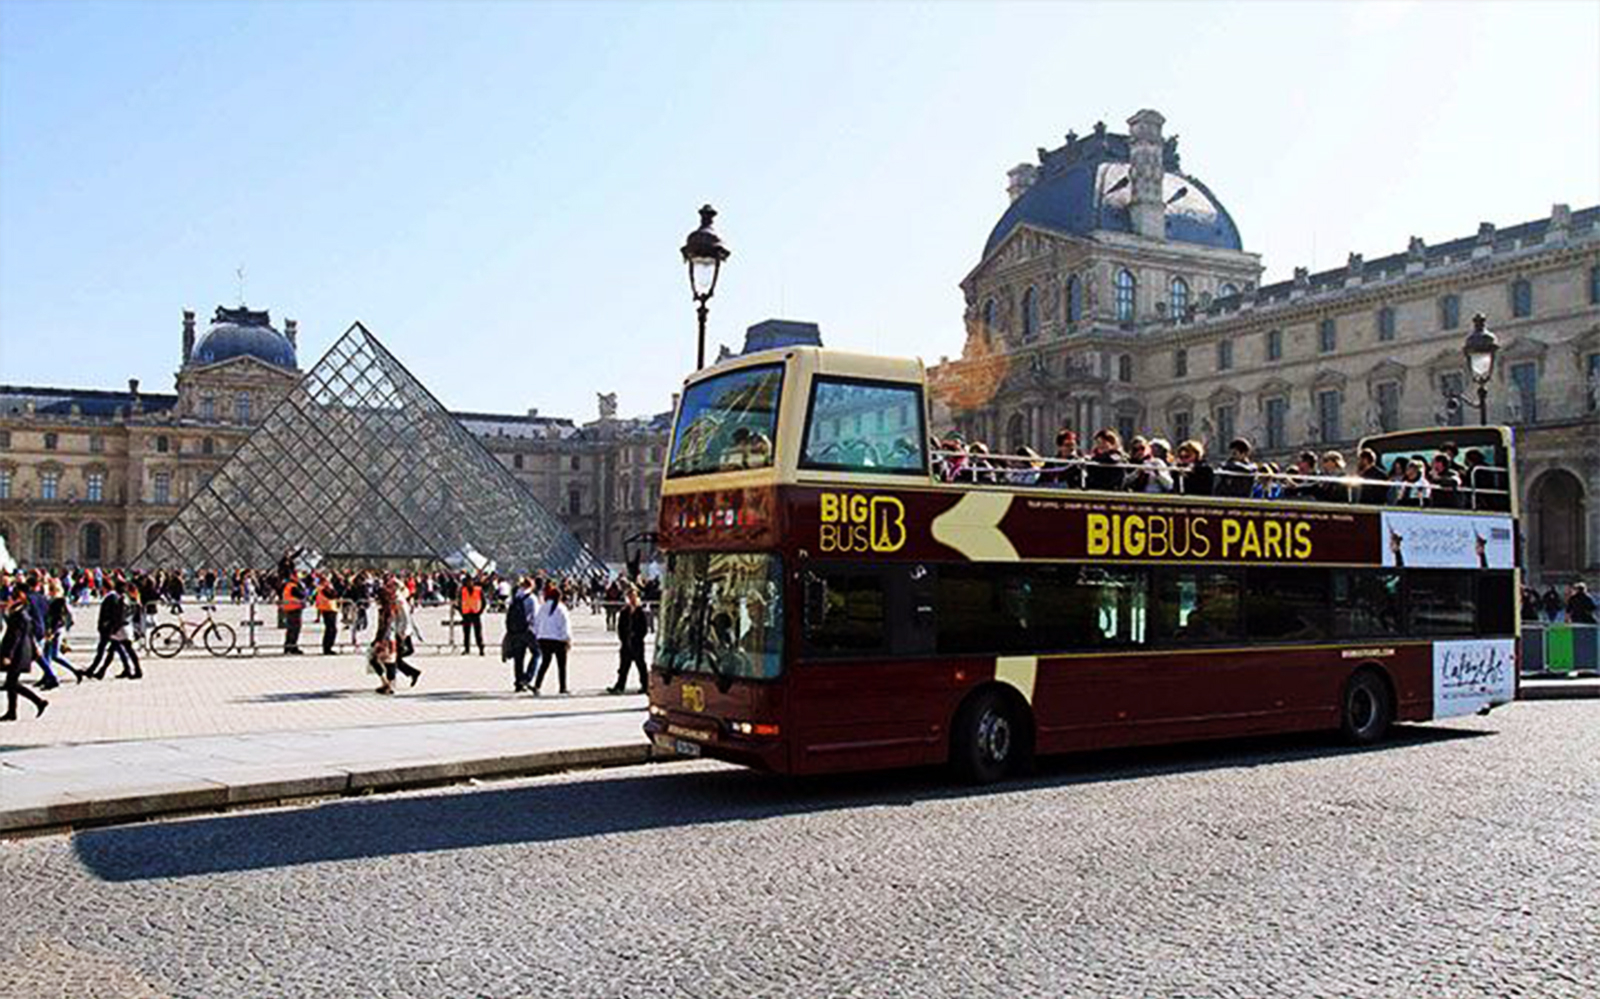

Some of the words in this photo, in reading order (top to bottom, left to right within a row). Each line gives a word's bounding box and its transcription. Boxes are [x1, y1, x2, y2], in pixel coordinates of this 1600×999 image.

[821, 493, 868, 523] BIG
[820, 524, 869, 552] BUS
[1221, 518, 1312, 559] PARIS
